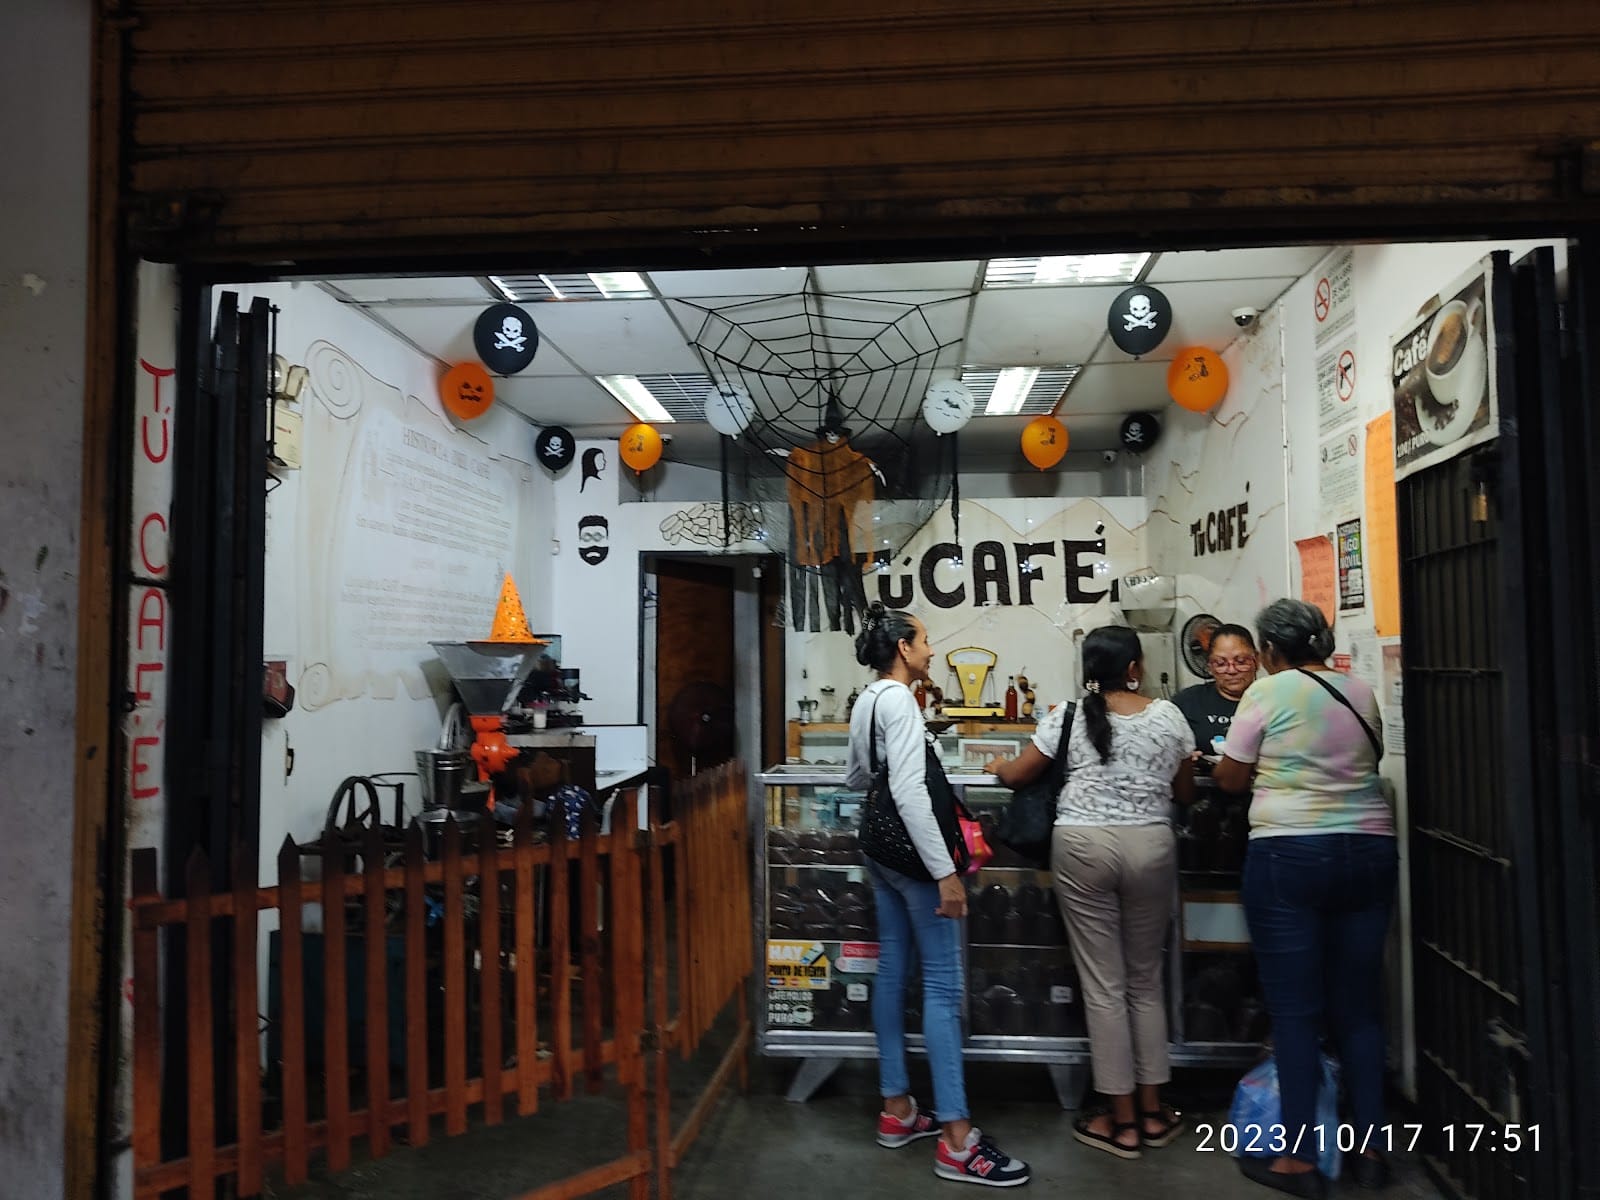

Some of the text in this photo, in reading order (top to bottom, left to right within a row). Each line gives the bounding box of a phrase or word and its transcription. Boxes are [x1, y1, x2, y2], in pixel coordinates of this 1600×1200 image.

[1393, 329, 1428, 376] Café
[1207, 715, 1234, 724] VO
[768, 945, 803, 961] HAY
